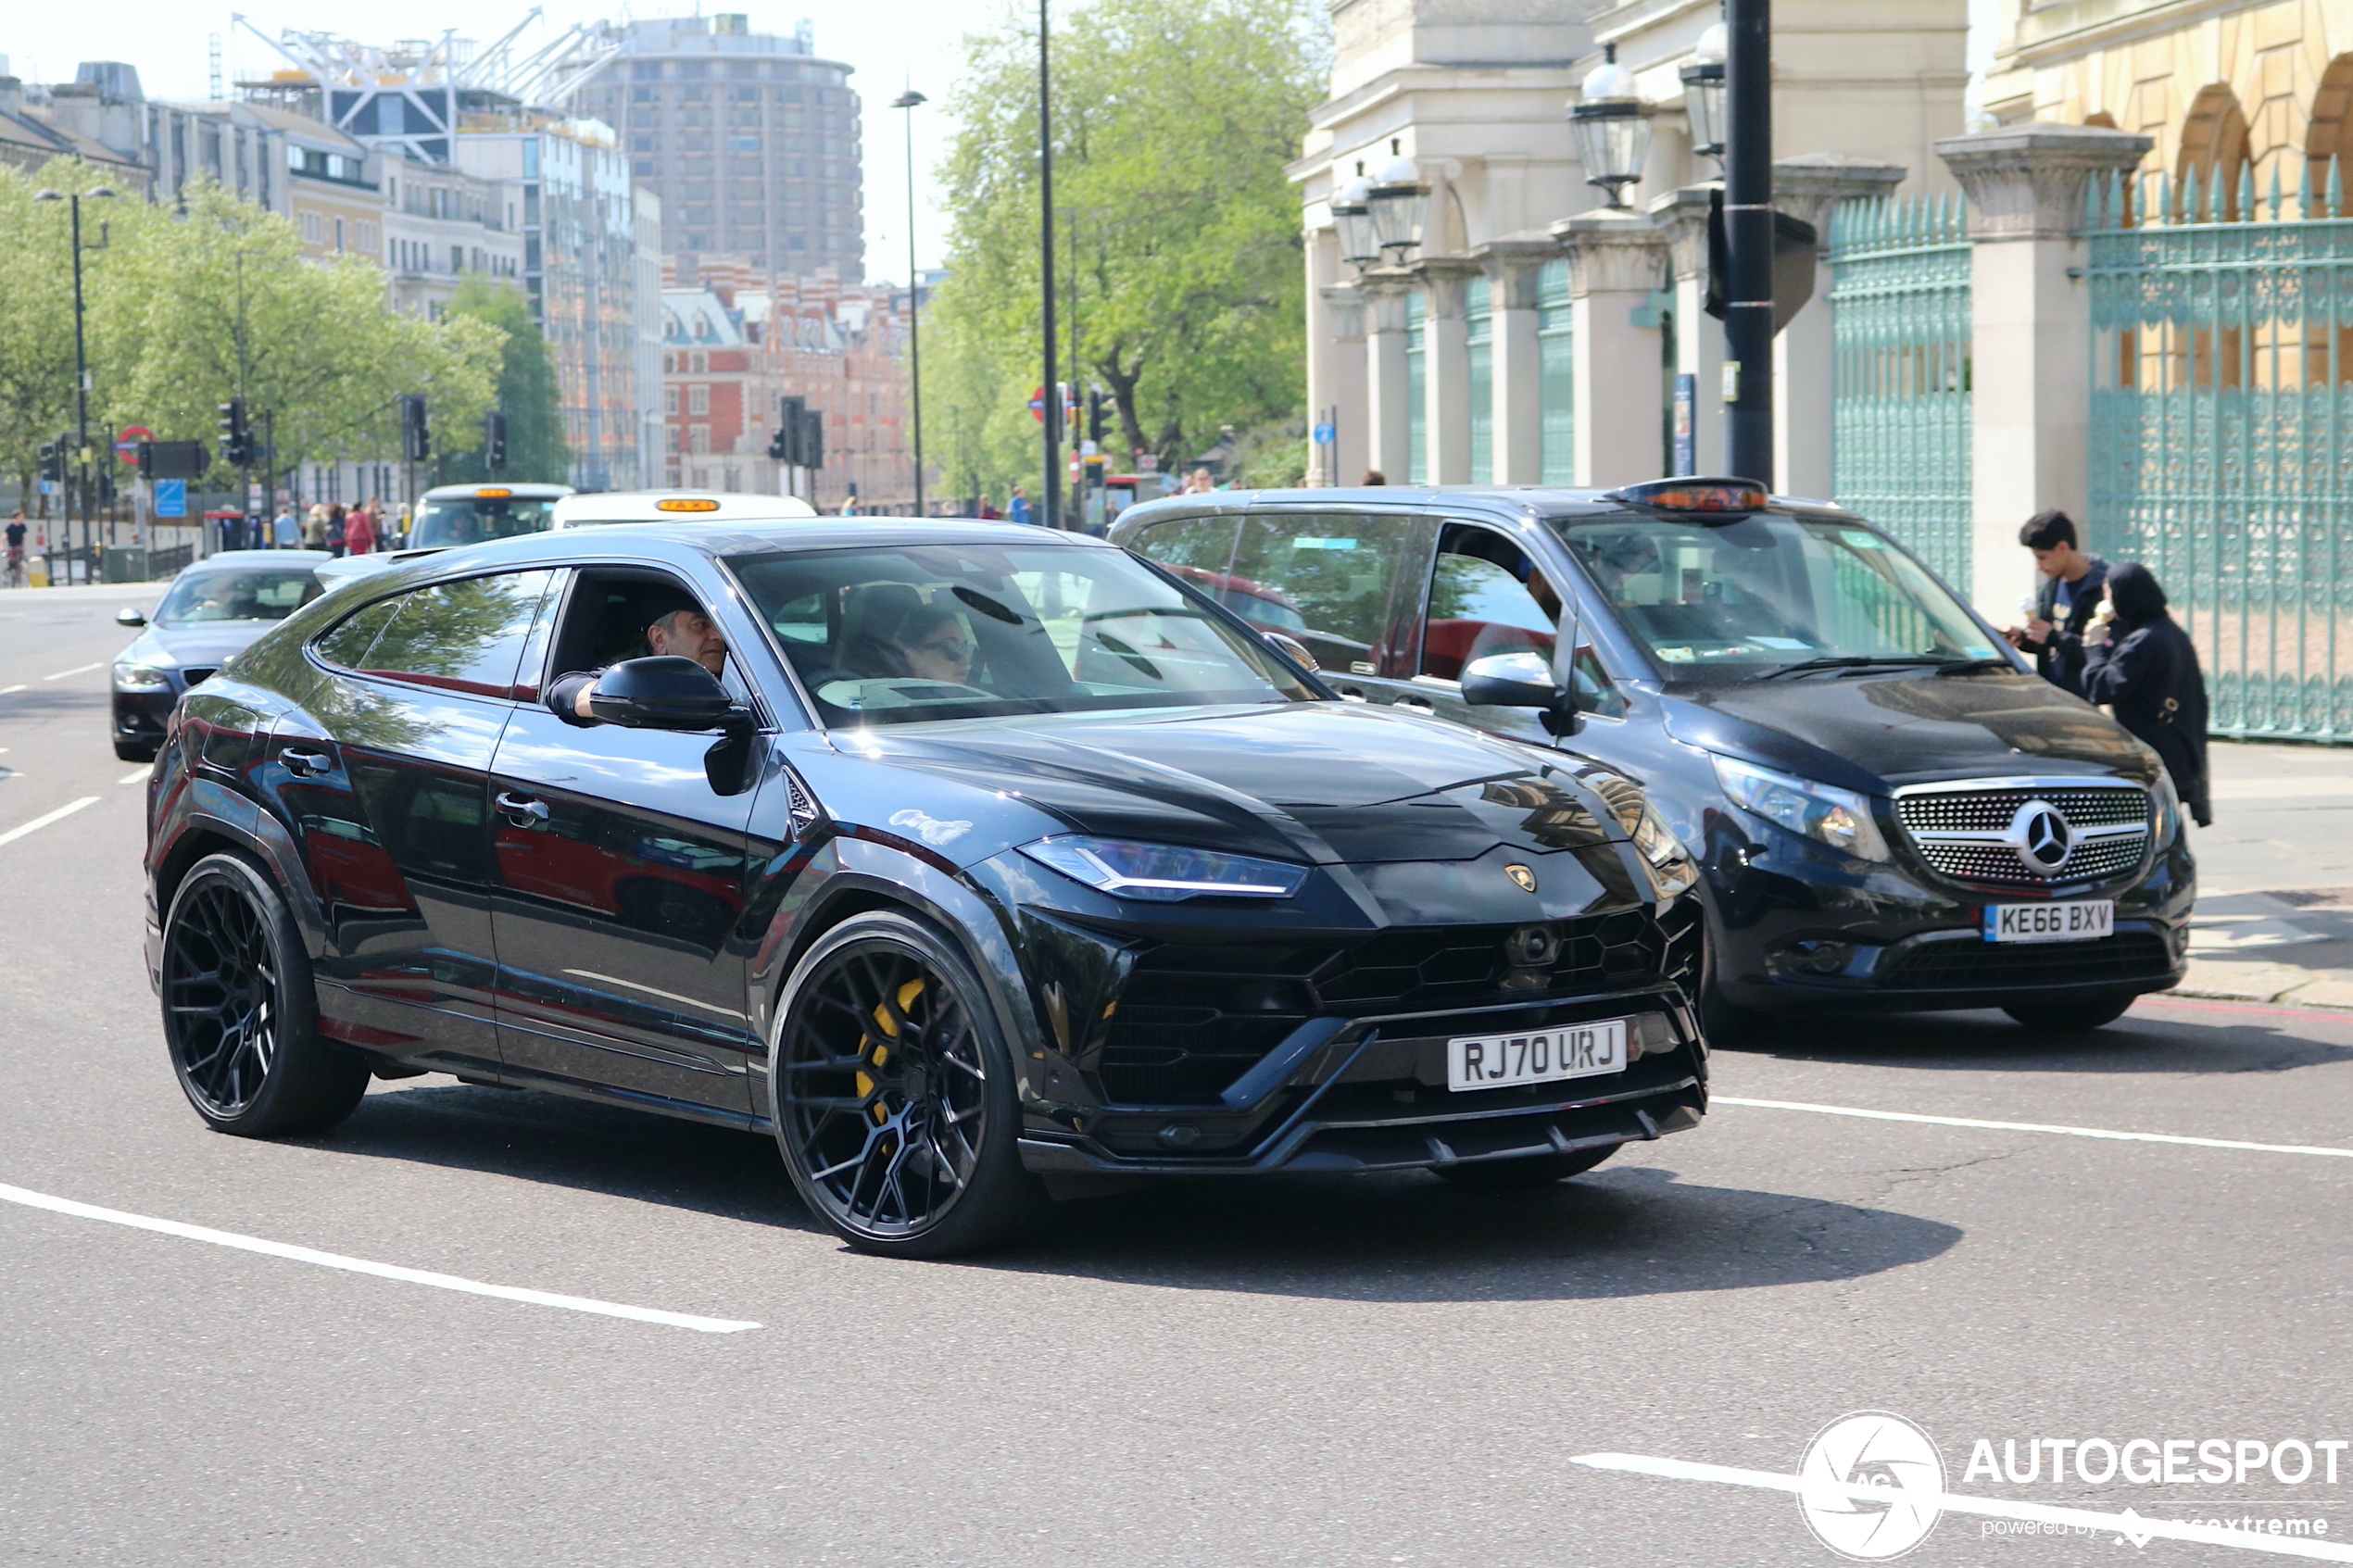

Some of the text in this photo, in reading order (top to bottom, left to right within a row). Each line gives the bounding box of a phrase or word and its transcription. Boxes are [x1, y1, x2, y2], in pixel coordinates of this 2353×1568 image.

[661, 500, 711, 511] TAXI
[1684, 487, 1751, 508] TAXI
[2002, 905, 2108, 934] KE66 BXV
[1465, 1027, 1614, 1082] RJ70 URJ
